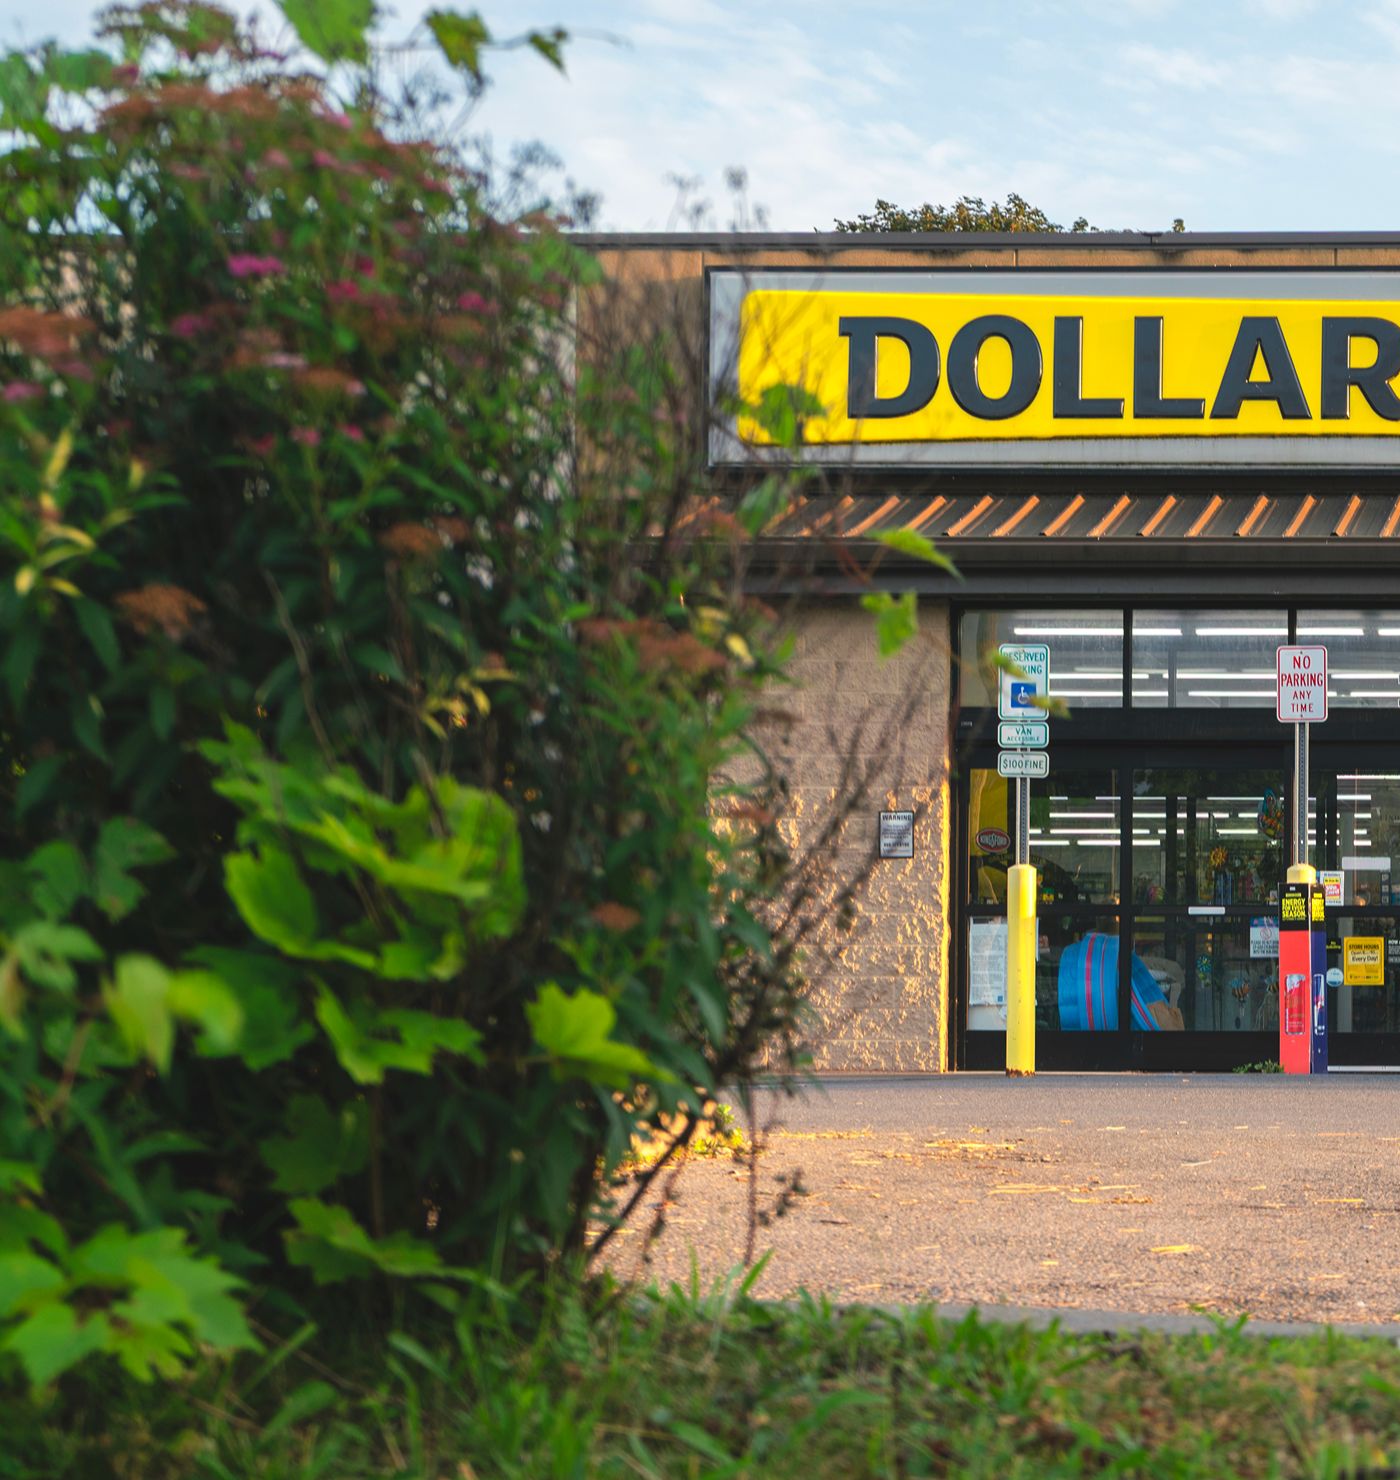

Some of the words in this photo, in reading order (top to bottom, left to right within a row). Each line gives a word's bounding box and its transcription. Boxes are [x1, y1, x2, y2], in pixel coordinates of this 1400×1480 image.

[1292, 655, 1311, 670] NO
[1280, 672, 1324, 687] PARKING
[1292, 690, 1312, 700] ANY
[1291, 703, 1314, 713] TIME
[1015, 727, 1032, 735] VAN
